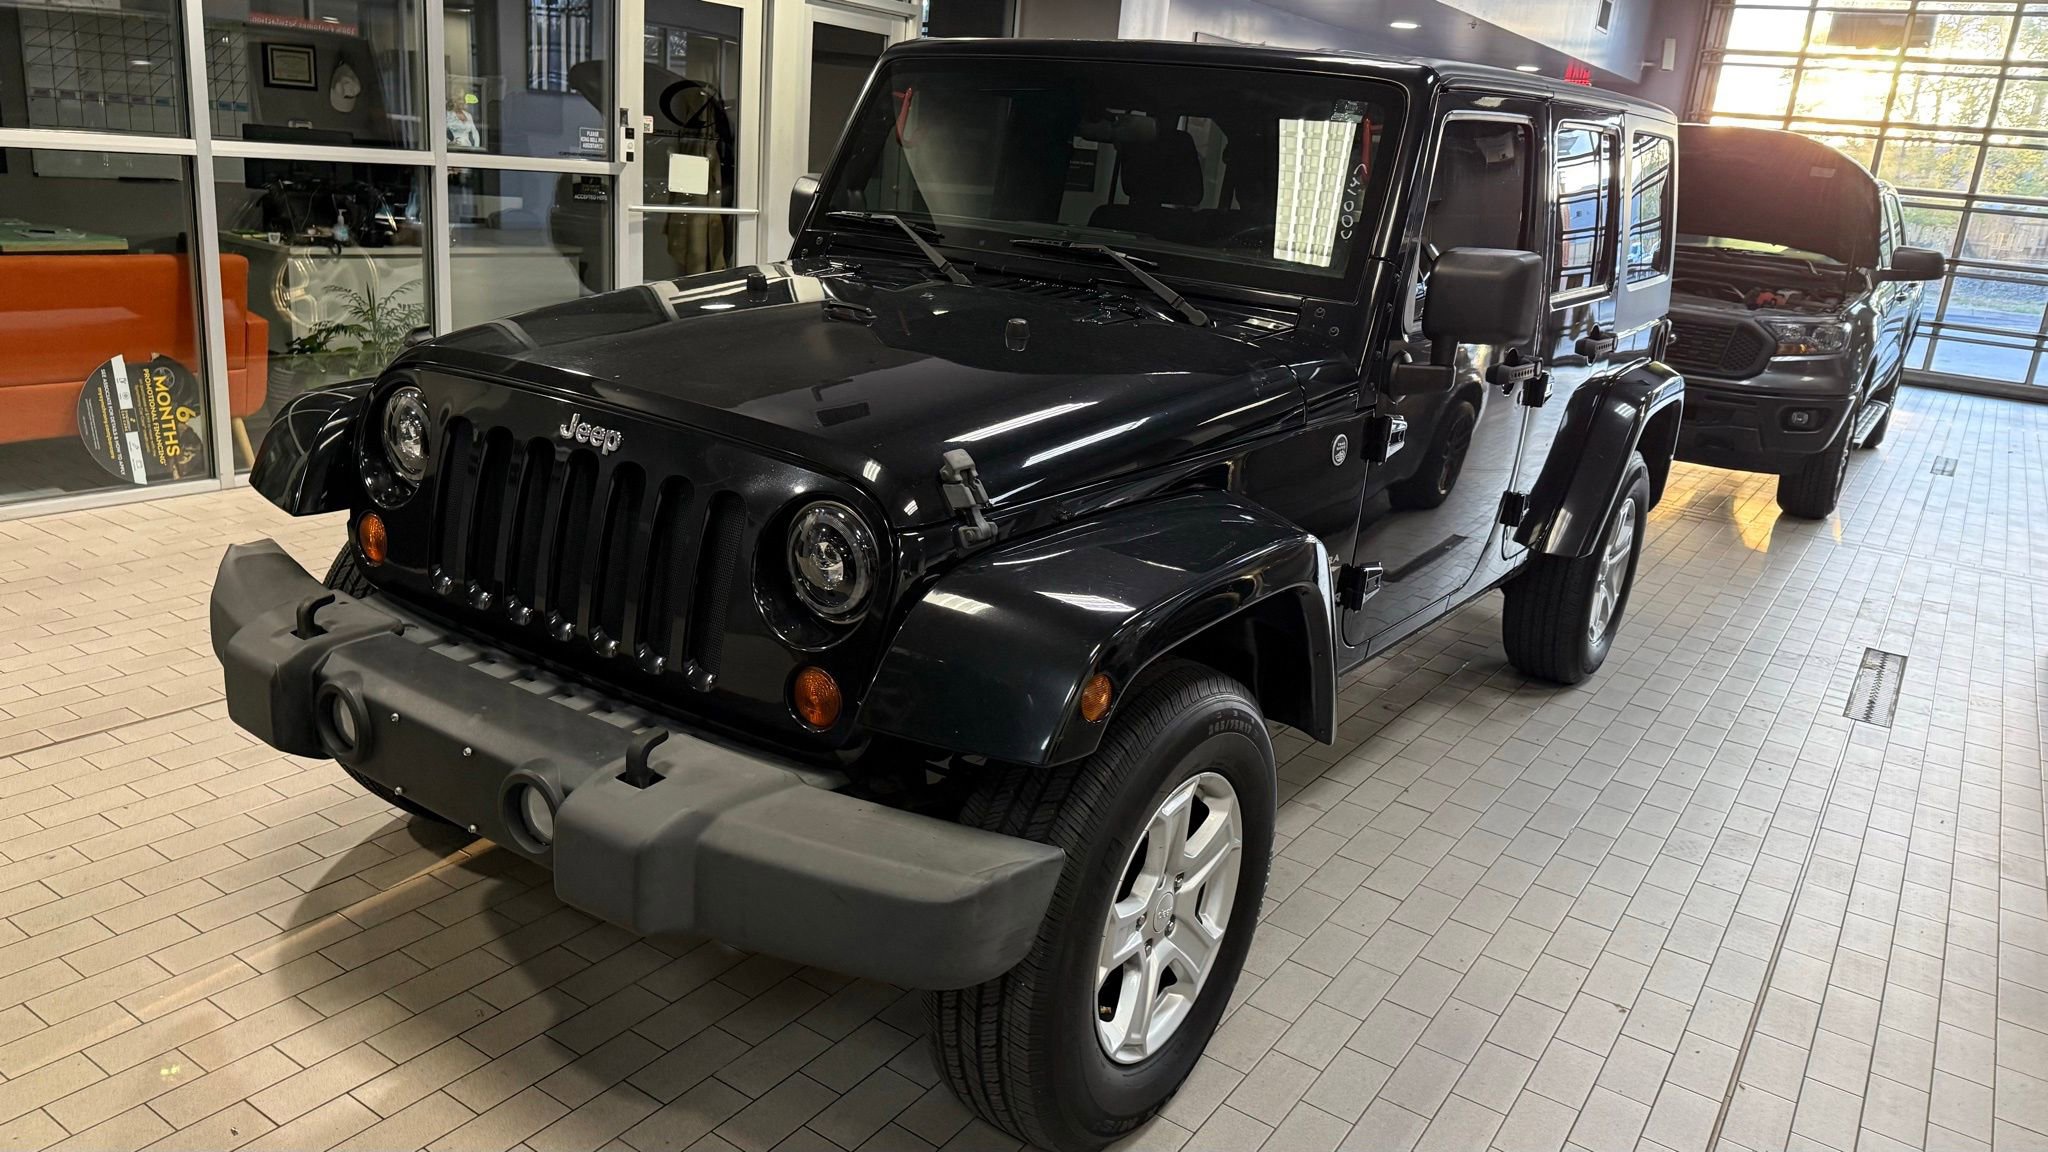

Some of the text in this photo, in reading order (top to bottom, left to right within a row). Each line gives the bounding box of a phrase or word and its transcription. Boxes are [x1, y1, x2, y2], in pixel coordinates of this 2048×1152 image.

[102, 378, 112, 406] ASSOCIATE
[110, 416, 118, 435] DETAILS
[117, 453, 123, 461] TO
[143, 368, 157, 421] PROMOTIONAL
[153, 374, 180, 457] MONTHS
[175, 405, 196, 424] 6
[560, 413, 621, 456] Jeep
